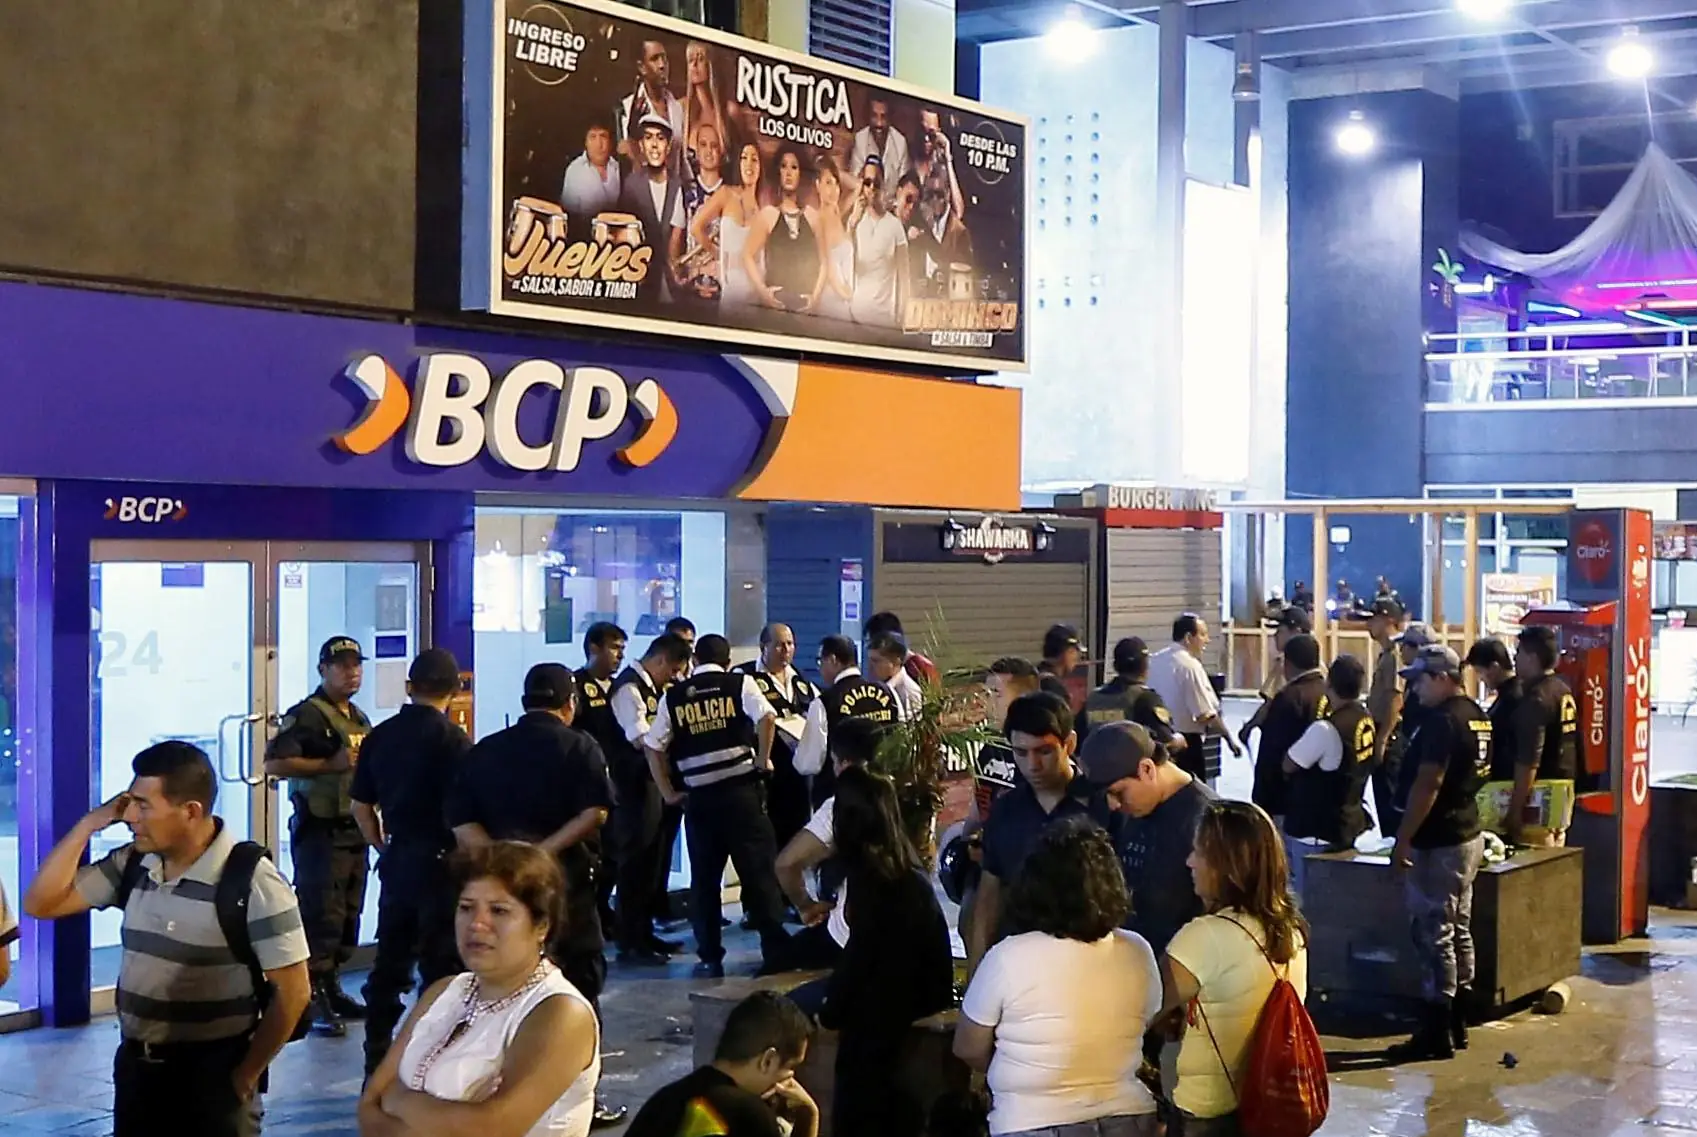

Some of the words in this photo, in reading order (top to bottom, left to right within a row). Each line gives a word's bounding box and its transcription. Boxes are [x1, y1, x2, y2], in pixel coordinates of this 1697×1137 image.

[508, 18, 585, 51] INGRESO
[515, 39, 579, 71] LIBRE
[760, 116, 785, 138] LOS
[786, 123, 833, 149] OLIVOS
[960, 132, 995, 152] DESDE
[996, 141, 1017, 158] LAS
[968, 149, 983, 167] 10
[985, 153, 1010, 173] P.M.
[504, 219, 653, 282] Jueves
[604, 281, 637, 299] TIMBA
[405, 353, 628, 472] BCP
[118, 497, 174, 522] BCP
[1108, 486, 1175, 511] BURGER
[1178, 488, 1218, 513] KING
[959, 527, 1029, 549] SHAWARMA
[97, 629, 163, 678] 24
[674, 696, 737, 728] POLICIA
[840, 684, 890, 716] POLICIA
[1590, 685, 1604, 746] Claro
[1630, 662, 1649, 806] Claro
